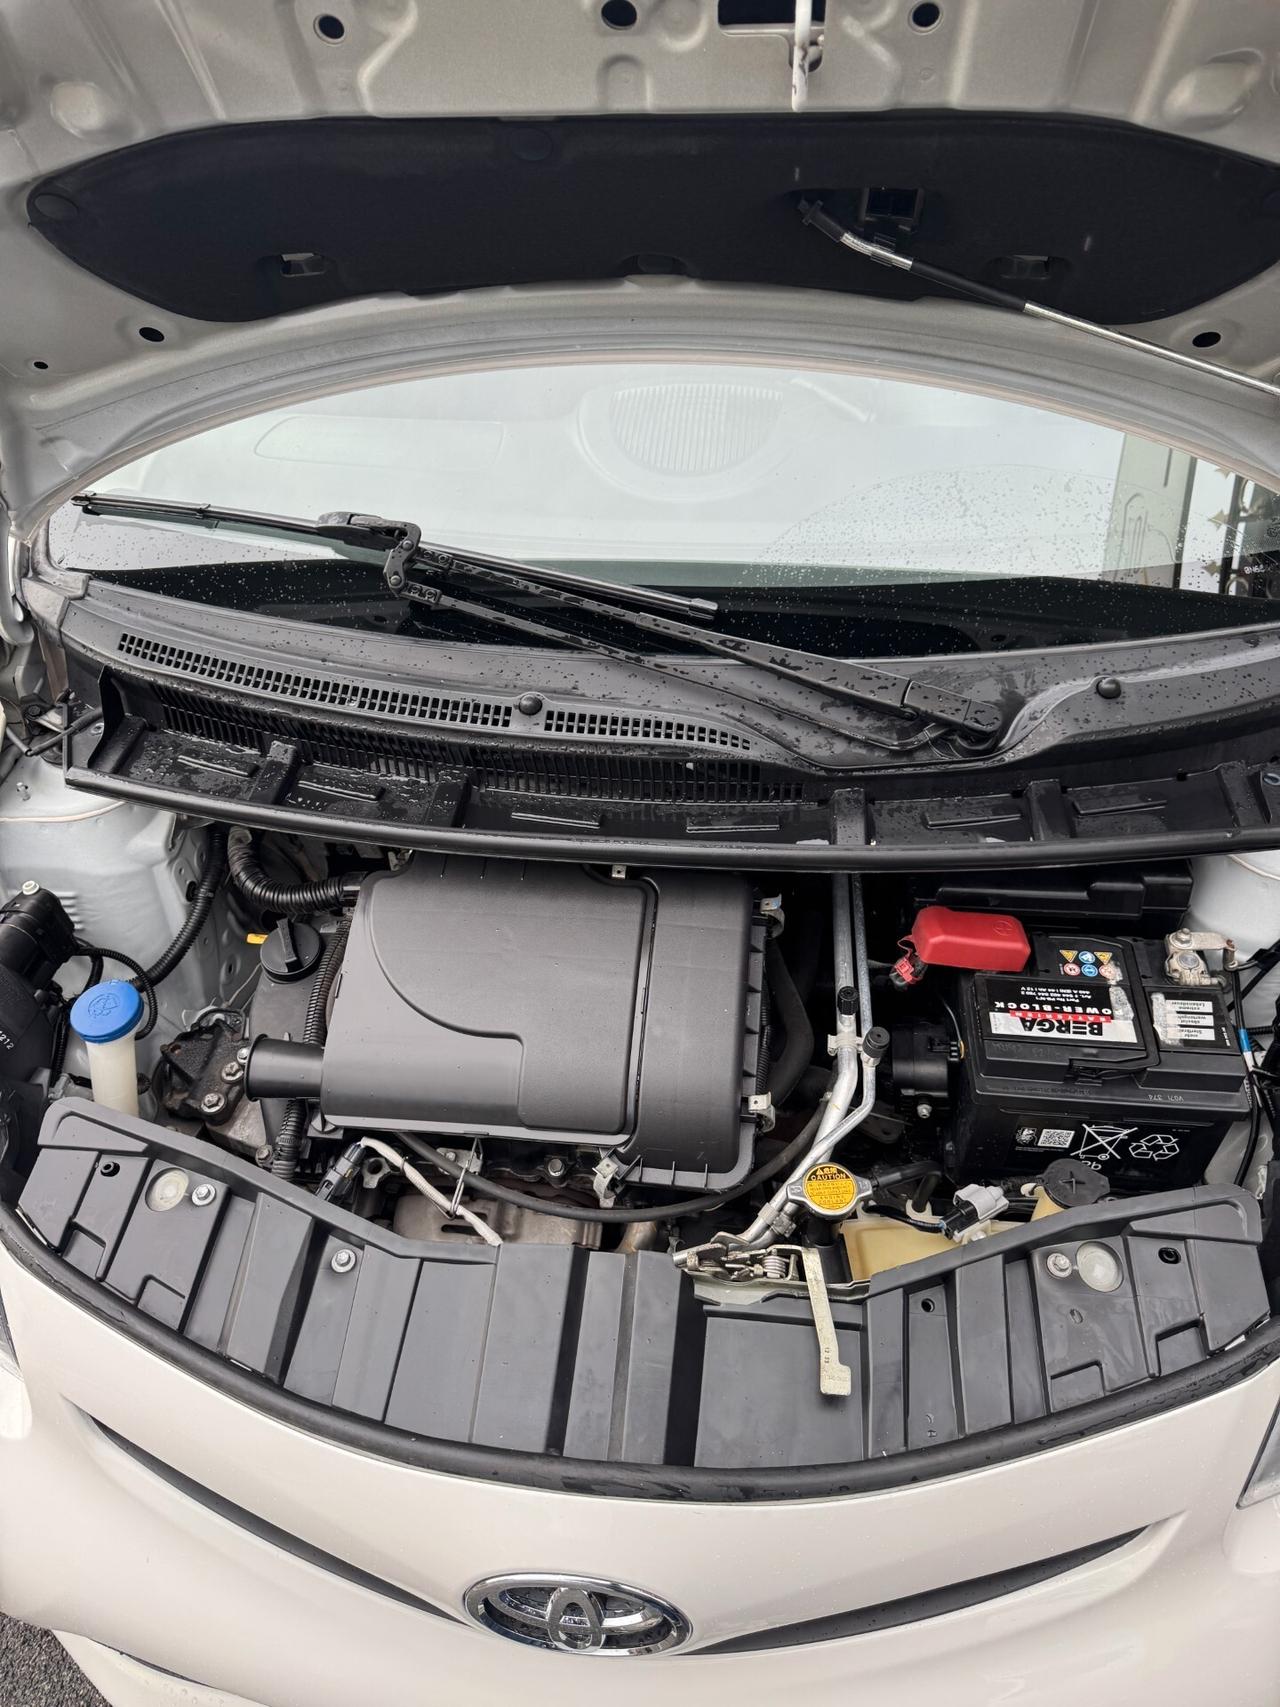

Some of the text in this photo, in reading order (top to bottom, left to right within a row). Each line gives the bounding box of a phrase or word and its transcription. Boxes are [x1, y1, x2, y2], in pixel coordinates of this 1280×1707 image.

[994, 1001, 1124, 1015] POWER-BLOCK
[1020, 1018, 1103, 1036] BERGA
[811, 1173, 846, 1181] CAUTION
